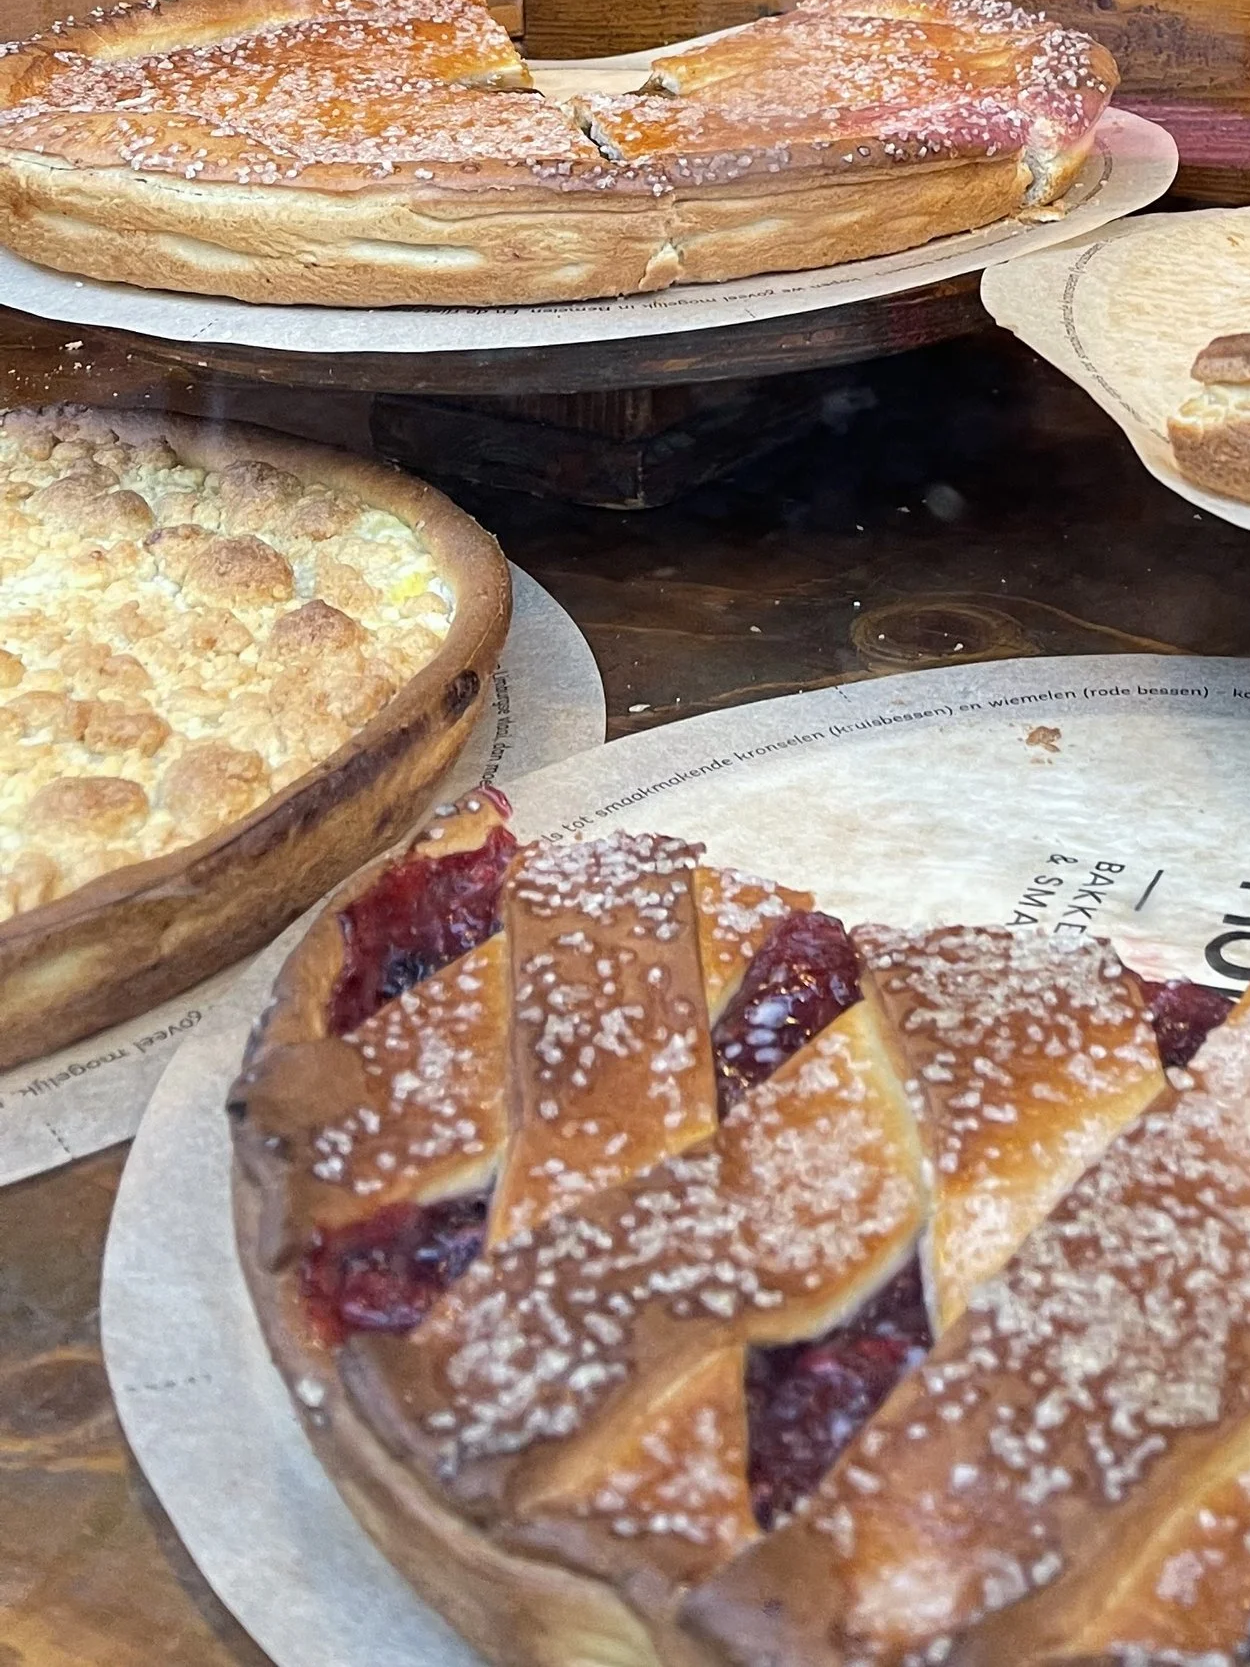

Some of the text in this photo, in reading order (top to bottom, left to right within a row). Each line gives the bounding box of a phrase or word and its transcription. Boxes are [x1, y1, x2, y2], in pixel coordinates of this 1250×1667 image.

[479, 763, 500, 788] moe
[561, 814, 594, 833] tot
[595, 757, 733, 819] smaakmakende
[733, 730, 826, 763] kronselen
[828, 704, 954, 739] (kruisbessen)
[959, 701, 982, 714] en
[988, 688, 1077, 710] wiemelen
[1083, 685, 1131, 701] (rode
[1137, 684, 1210, 700] bessen)
[1005, 853, 1079, 928] & SMA
[1054, 858, 1126, 936] BAKKE
